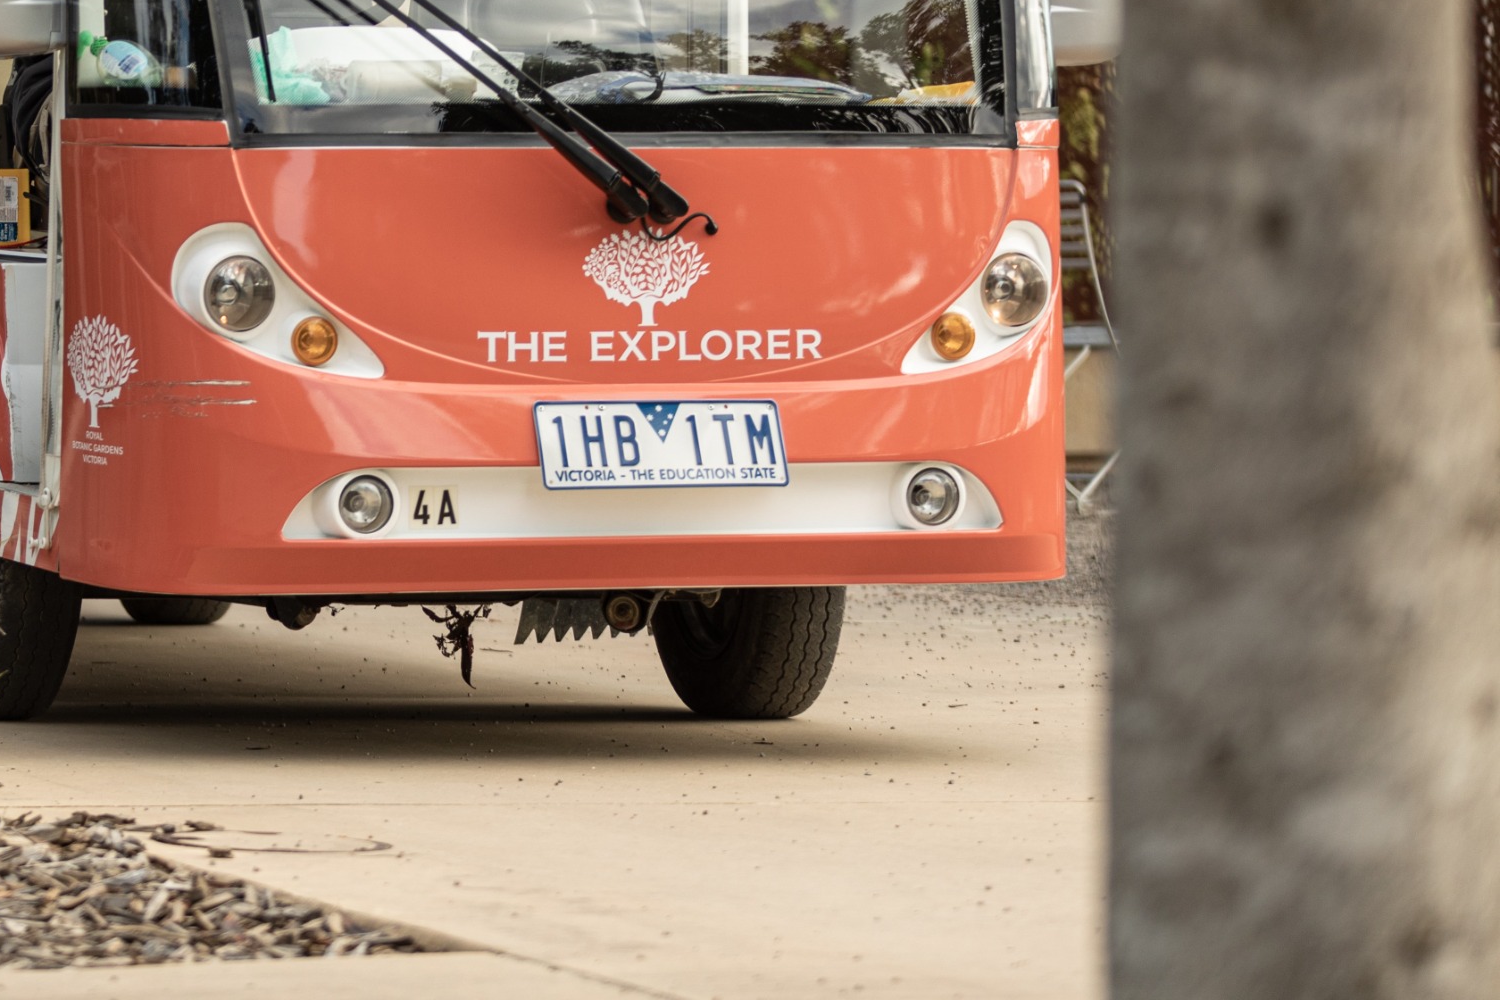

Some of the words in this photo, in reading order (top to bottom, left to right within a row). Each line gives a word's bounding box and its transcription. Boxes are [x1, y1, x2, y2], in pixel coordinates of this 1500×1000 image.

[477, 330, 567, 362] THE
[590, 329, 822, 361] EXPLORER
[85, 430, 104, 441] ROYAL
[552, 415, 640, 467] 1HB
[685, 414, 777, 466] 1TM
[72, 441, 93, 451] BOTANIC
[93, 444, 124, 456] GARDENS
[82, 454, 108, 465] VICTORIA
[555, 470, 616, 482] VICTORIA
[630, 469, 655, 480] THE
[660, 468, 736, 480] EDUCATION
[740, 468, 776, 479] STATE
[413, 489, 457, 525] 4A
